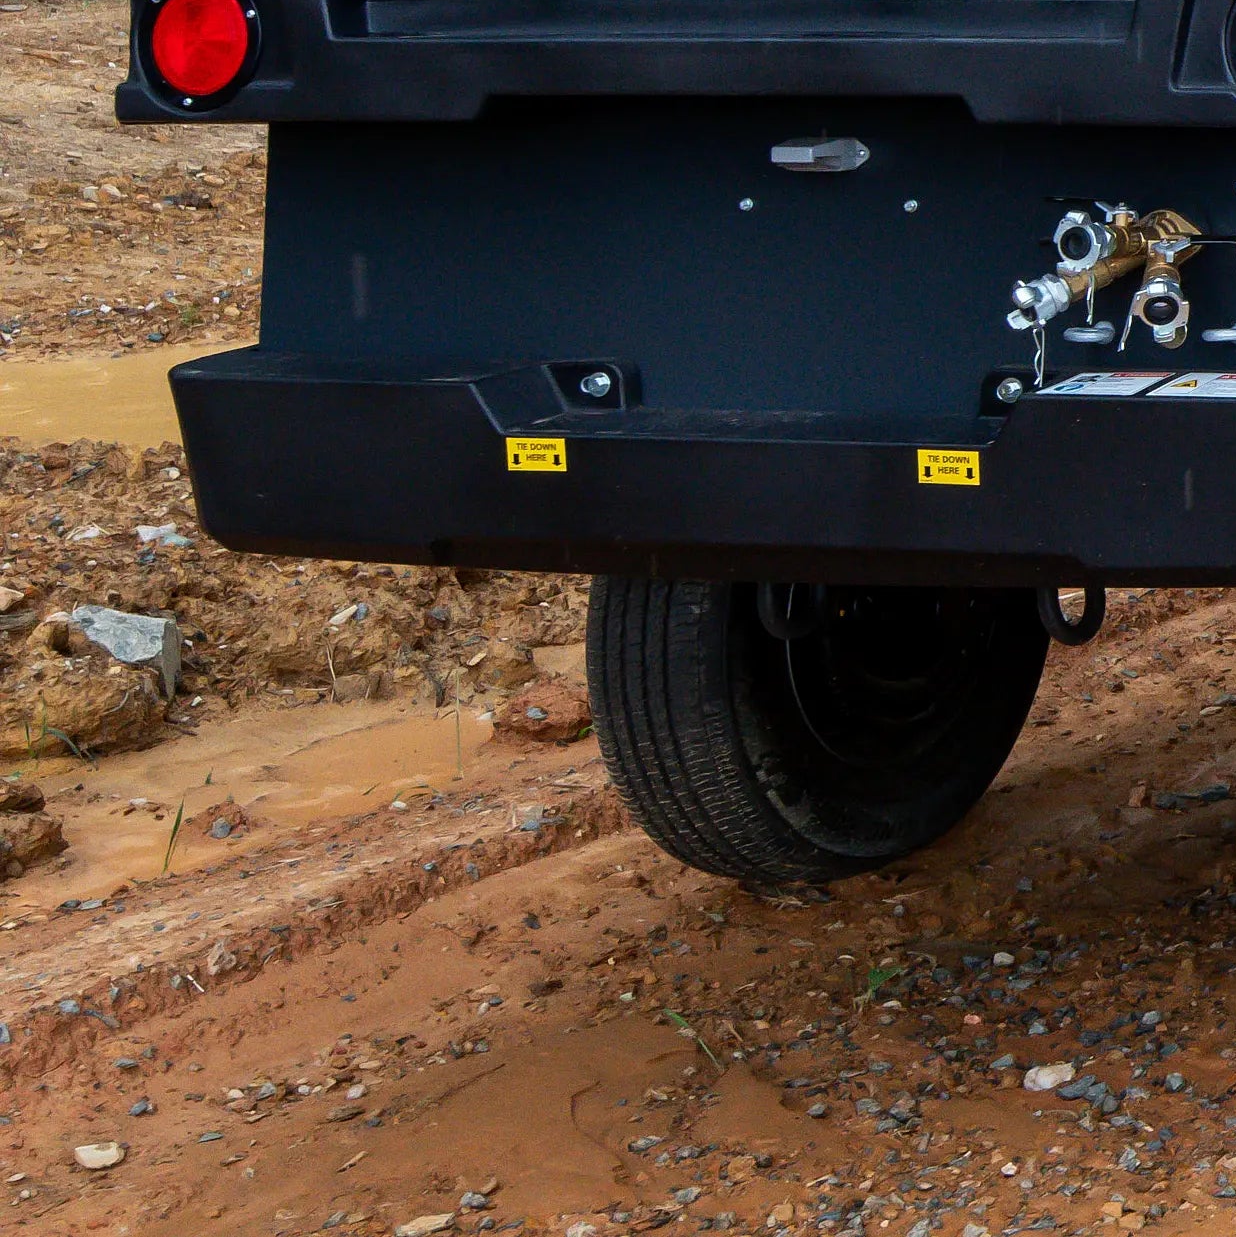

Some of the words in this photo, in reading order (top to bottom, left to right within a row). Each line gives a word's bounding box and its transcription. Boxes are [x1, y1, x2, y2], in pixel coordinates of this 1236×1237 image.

[516, 442, 528, 451] TIE
[530, 443, 557, 451] DOWN
[526, 453, 548, 462] HERE
[928, 454, 940, 463] TIE
[942, 455, 970, 464] DOWN
[938, 466, 960, 475] HERE
